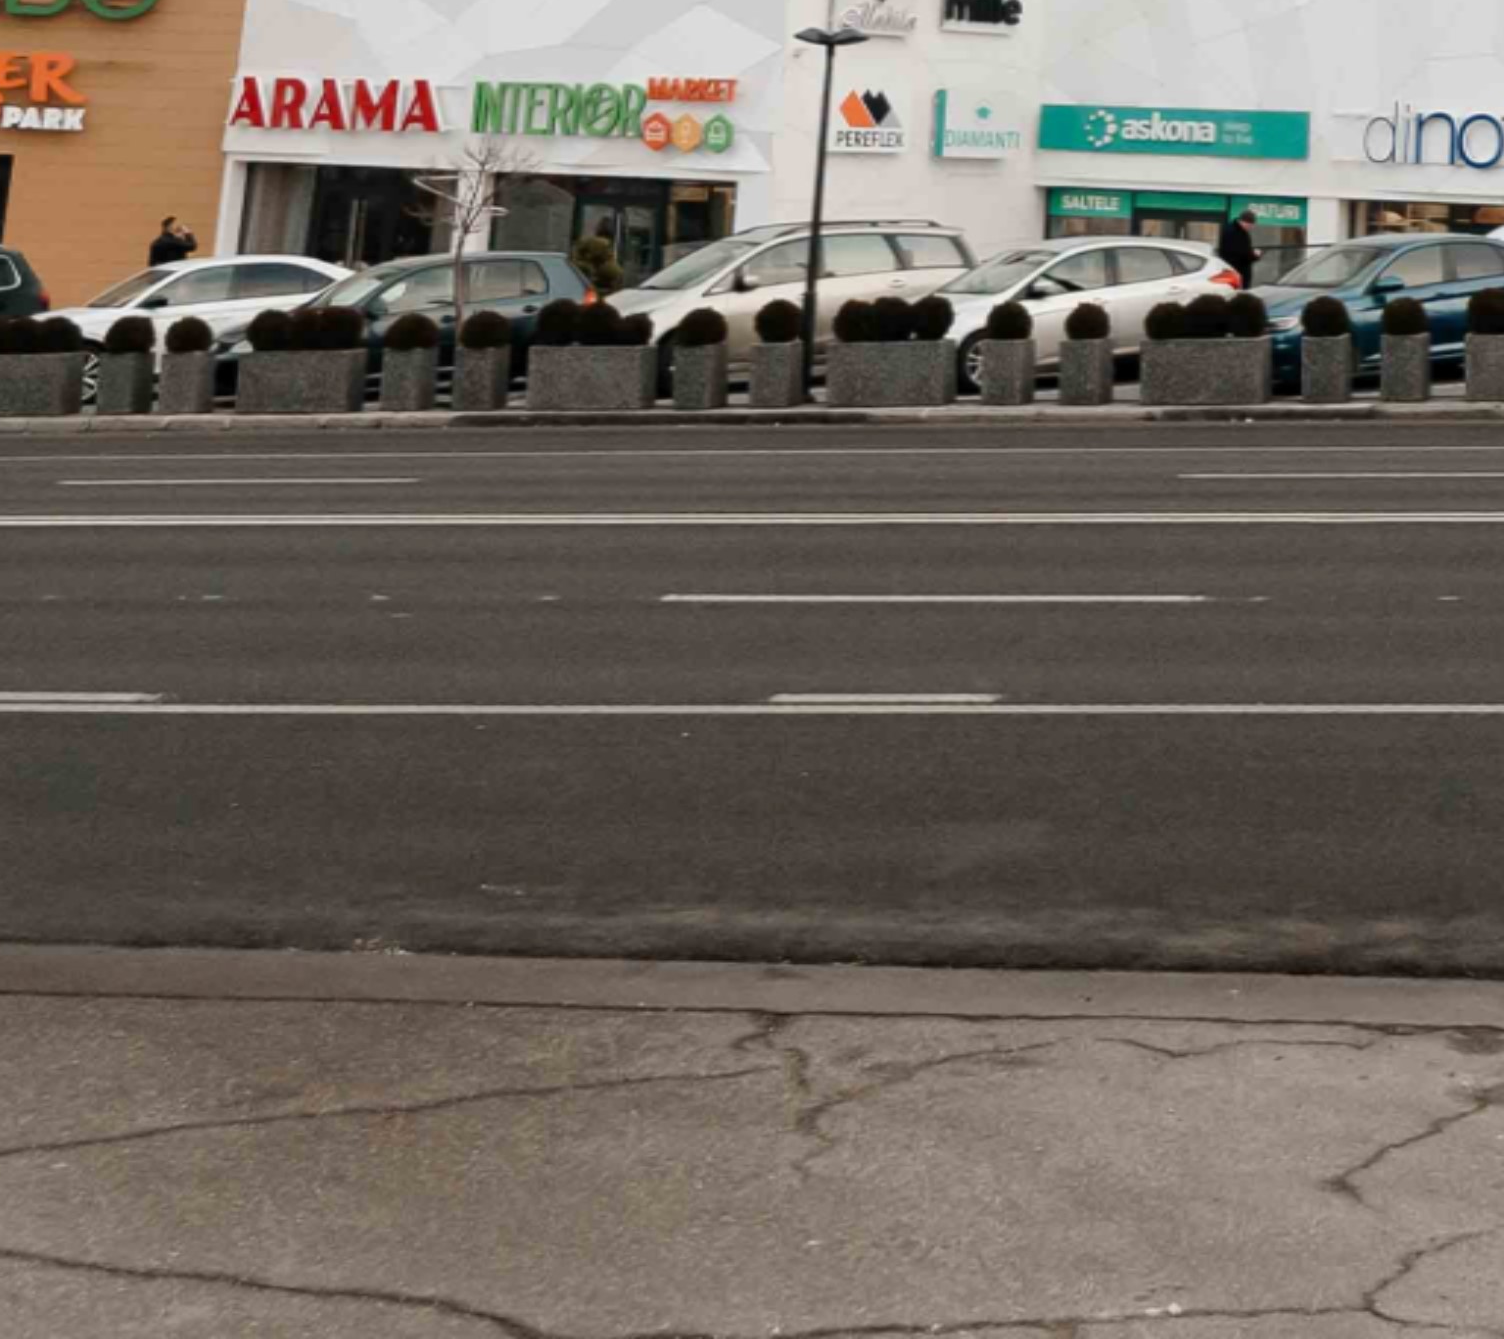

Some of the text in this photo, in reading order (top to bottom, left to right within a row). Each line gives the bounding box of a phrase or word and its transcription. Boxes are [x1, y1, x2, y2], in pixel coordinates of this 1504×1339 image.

[230, 76, 439, 133] ARAMA
[648, 77, 737, 103] MARKET
[0, 105, 86, 132] PARK
[470, 80, 646, 139] INTERIOR
[1121, 111, 1216, 143] askona
[1061, 194, 1122, 211] SALTELE
